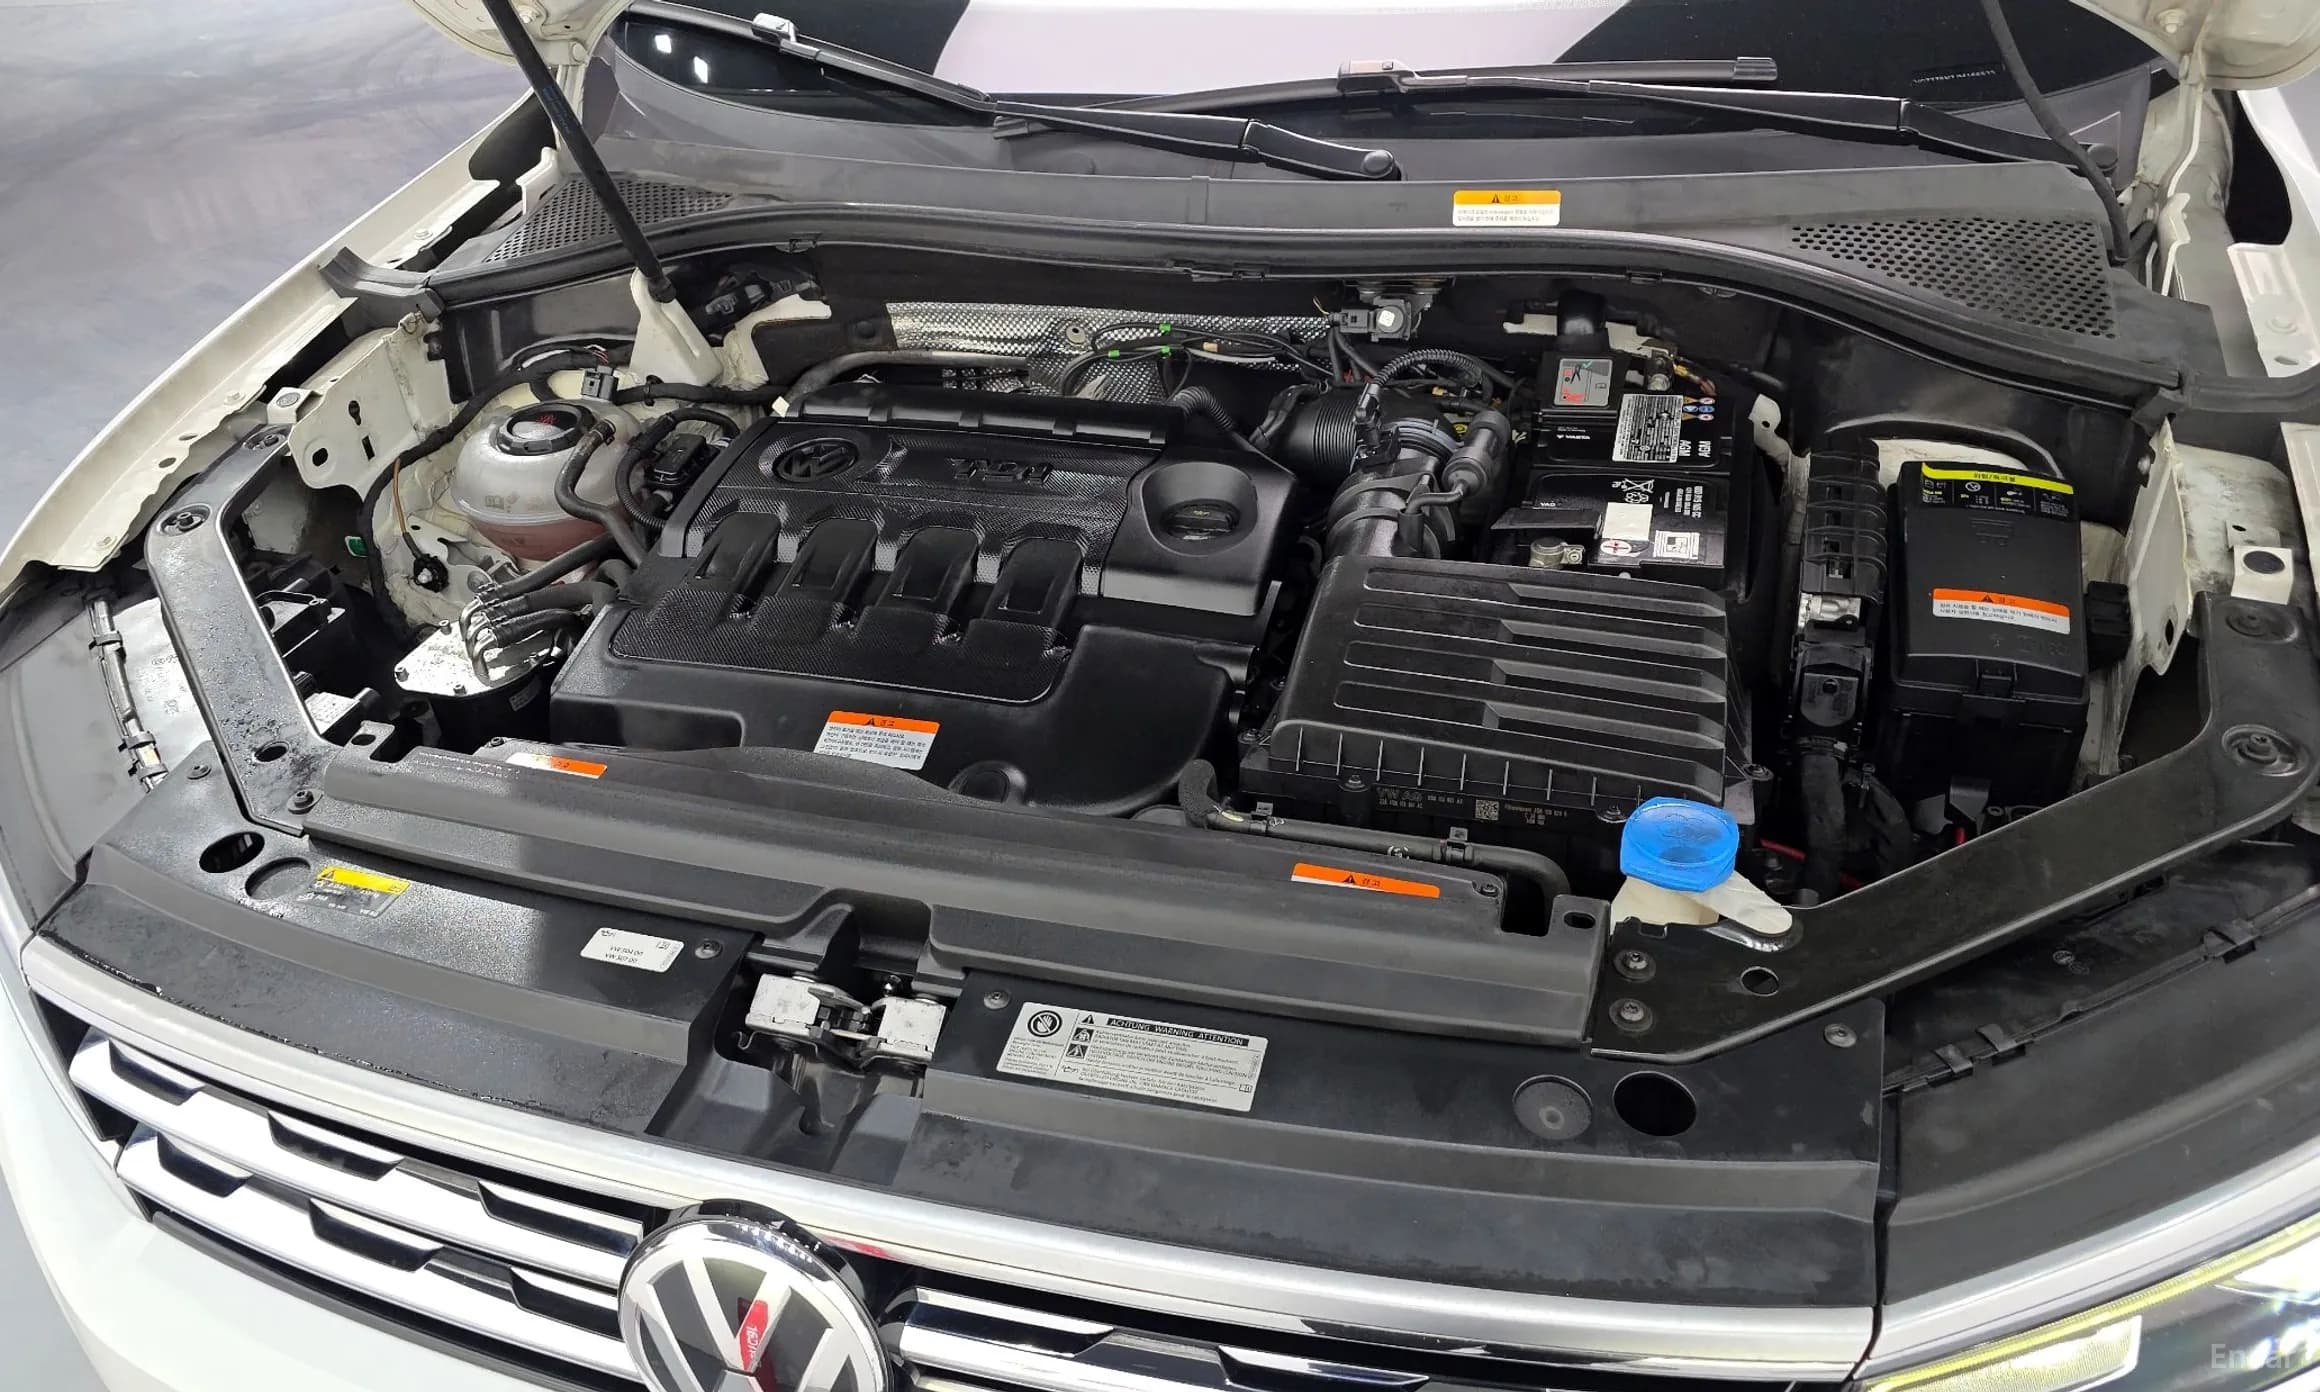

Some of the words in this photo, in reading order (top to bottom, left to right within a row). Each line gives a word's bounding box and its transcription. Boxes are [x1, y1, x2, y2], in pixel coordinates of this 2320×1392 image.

[1109, 1018, 1151, 1032] ACHTUNG
[1155, 1025, 1195, 1038] WARNING
[1198, 1032, 1244, 1046] ATTENTION
